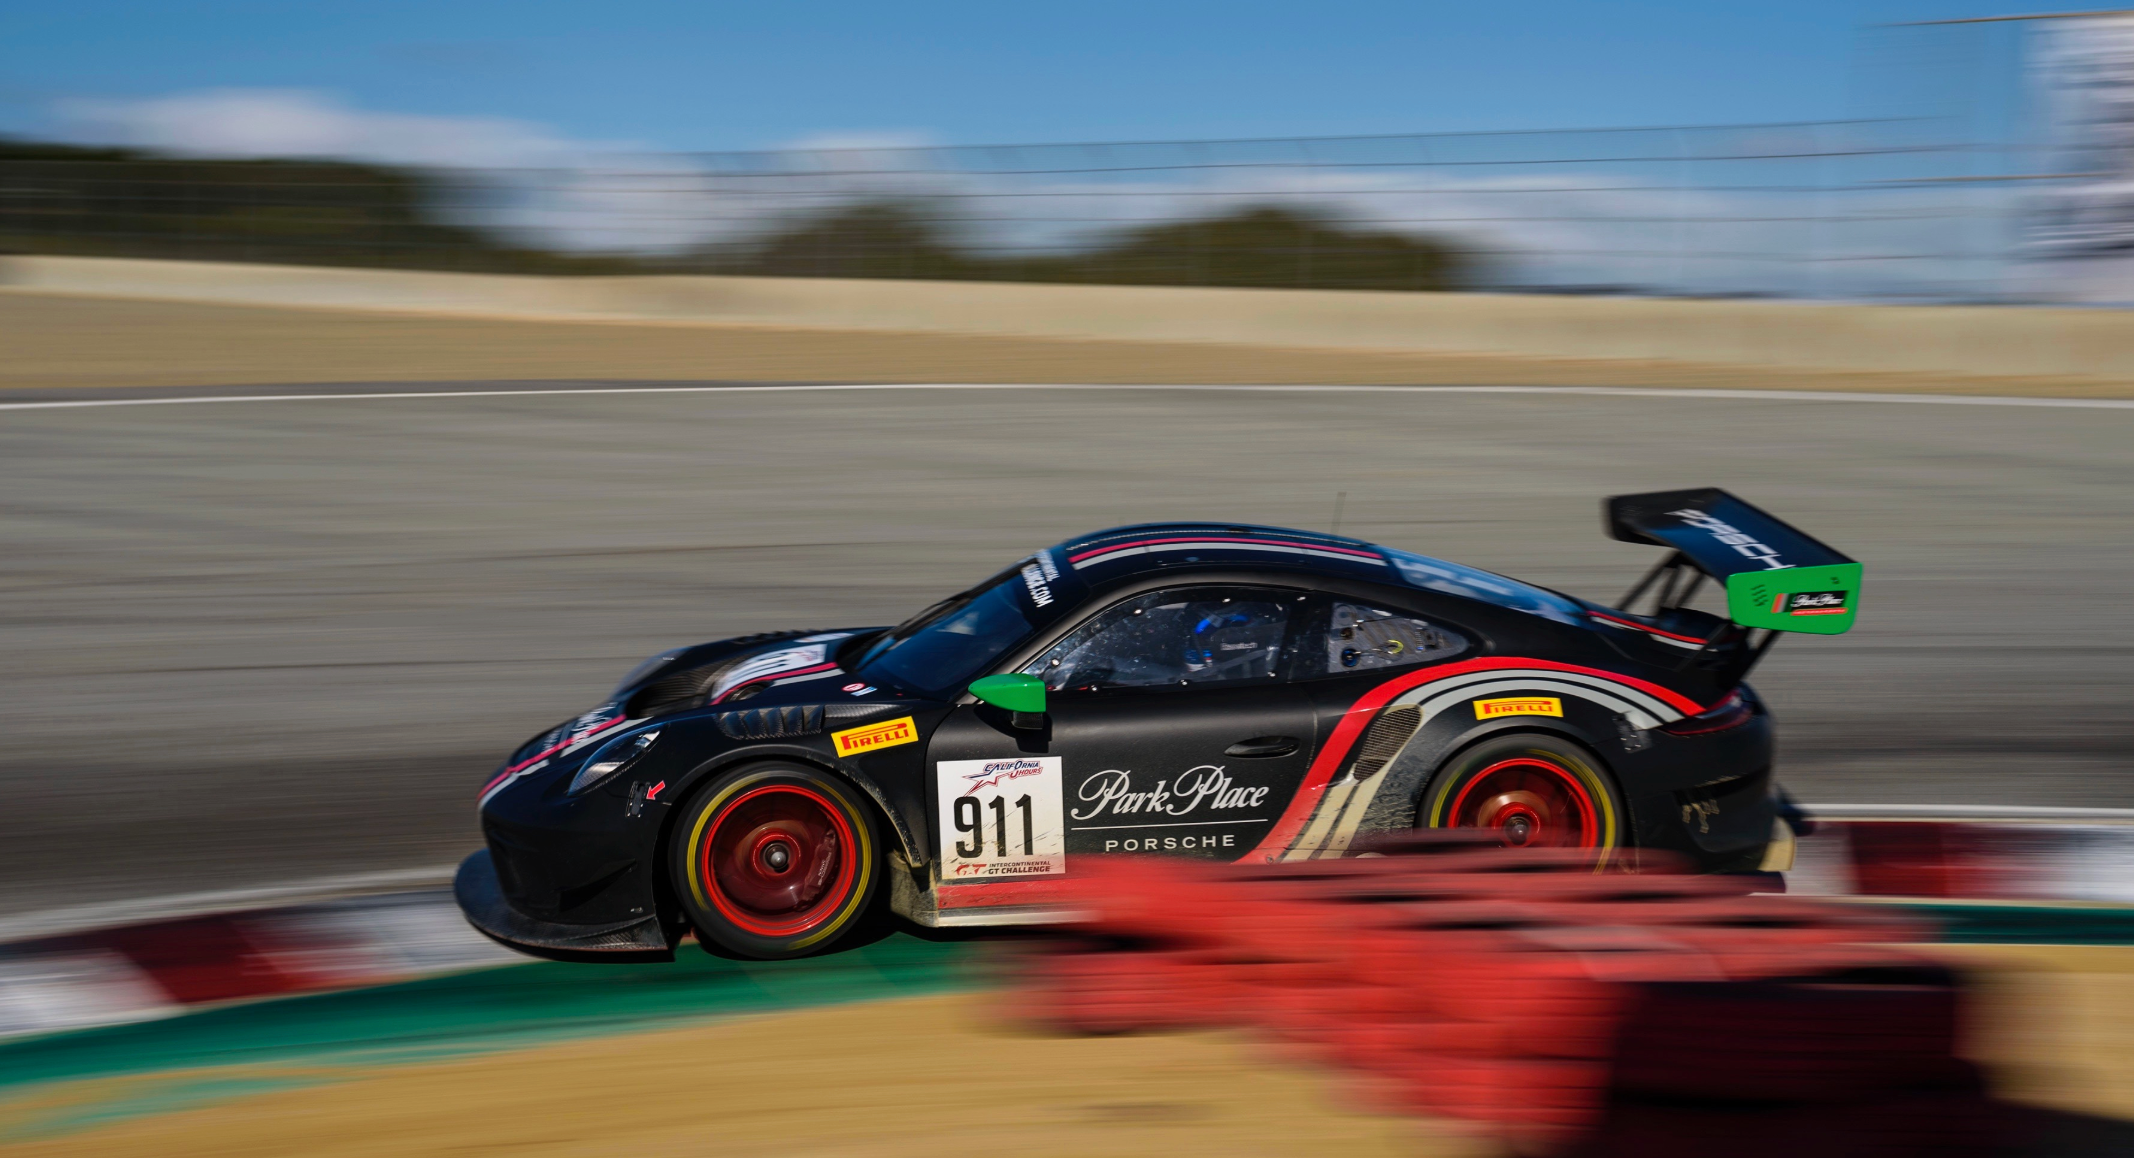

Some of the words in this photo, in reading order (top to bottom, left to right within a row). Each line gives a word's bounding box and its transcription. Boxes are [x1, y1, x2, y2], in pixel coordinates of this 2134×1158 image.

[1483, 700, 1554, 715] PIRELLI
[840, 722, 909, 751] PIRELLI
[985, 760, 1039, 771] CALIFORNIA
[1071, 769, 1170, 820] Park
[1165, 765, 1270, 816] Place
[953, 794, 1034, 859] 911
[1105, 834, 1235, 852] PORSCHE
[989, 860, 1051, 868] INTERCONTINENTAL
[1001, 866, 1051, 874] CHALLENGE
